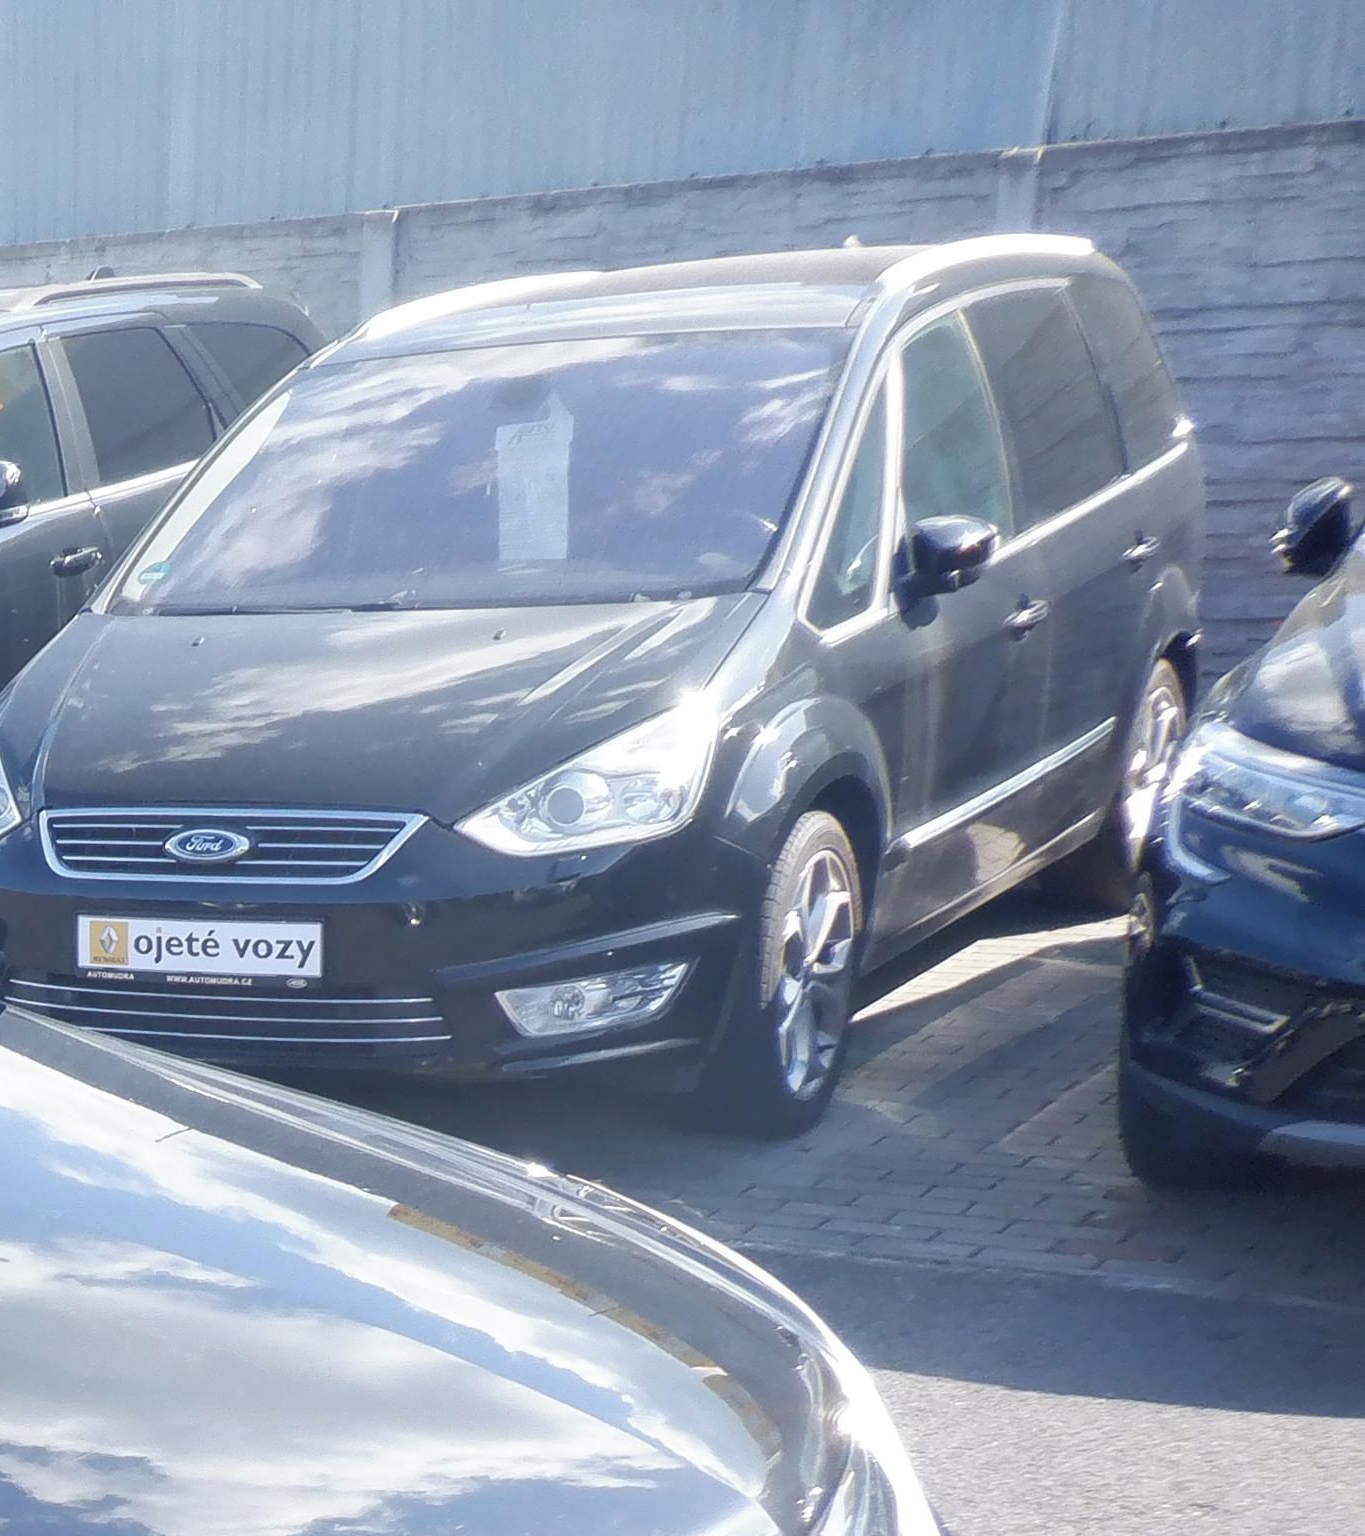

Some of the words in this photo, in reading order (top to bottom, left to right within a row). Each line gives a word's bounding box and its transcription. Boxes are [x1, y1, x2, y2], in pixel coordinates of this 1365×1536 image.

[185, 835, 224, 851] Ford
[134, 927, 220, 964] ojeté
[232, 938, 316, 969] vozy
